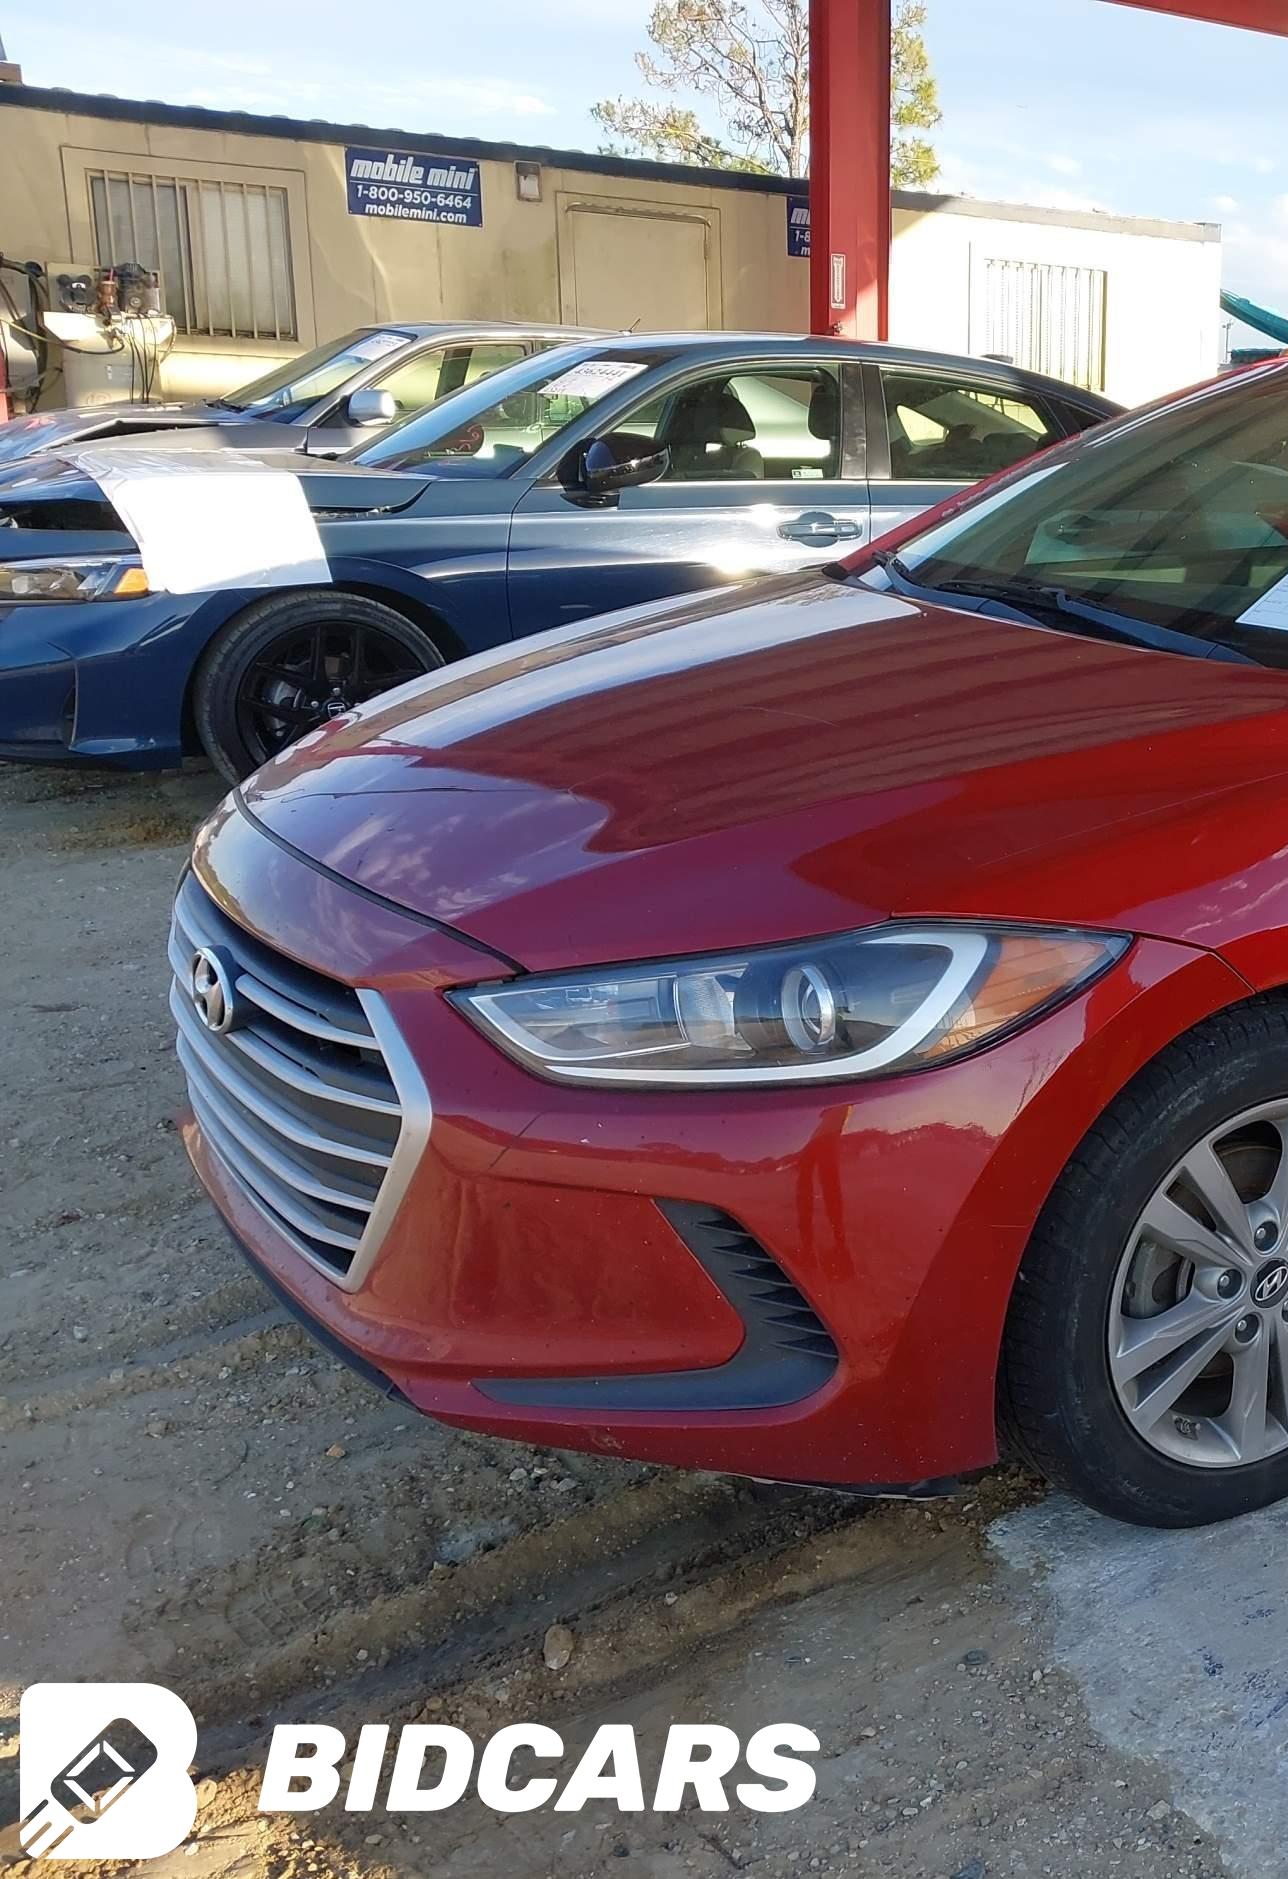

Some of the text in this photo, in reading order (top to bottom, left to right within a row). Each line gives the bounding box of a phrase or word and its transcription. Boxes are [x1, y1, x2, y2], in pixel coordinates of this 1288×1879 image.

[350, 154, 476, 190] mobile mini
[356, 185, 472, 209] 1-800-950-6464
[365, 203, 467, 224] mobilemini.com
